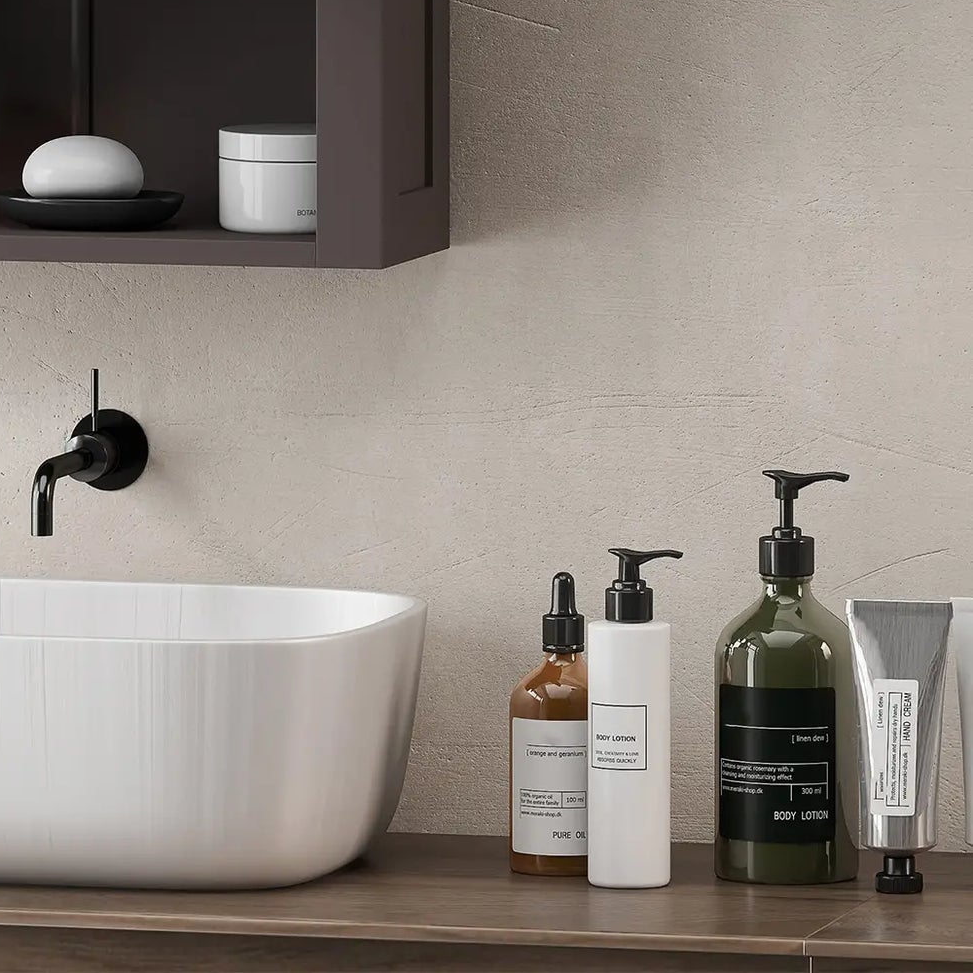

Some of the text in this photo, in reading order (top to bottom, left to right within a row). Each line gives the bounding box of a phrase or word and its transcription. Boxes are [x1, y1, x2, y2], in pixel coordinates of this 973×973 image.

[903, 721, 911, 741] HAND
[774, 810, 828, 820] BODY LOTION
